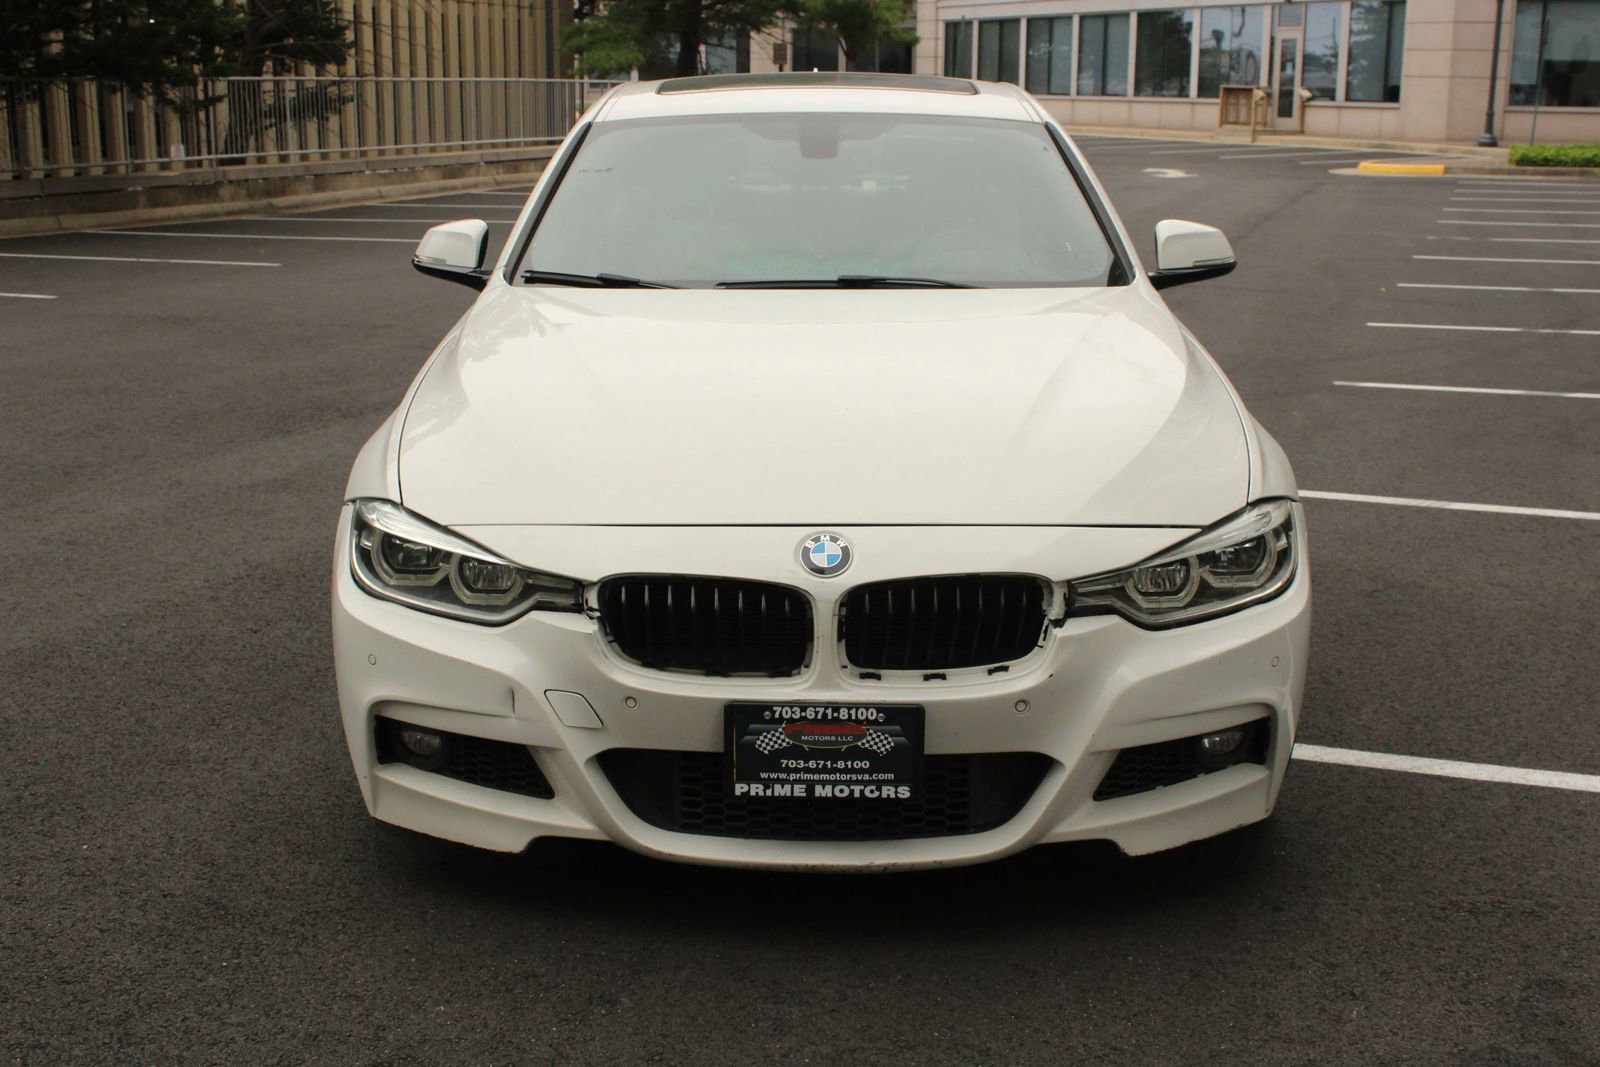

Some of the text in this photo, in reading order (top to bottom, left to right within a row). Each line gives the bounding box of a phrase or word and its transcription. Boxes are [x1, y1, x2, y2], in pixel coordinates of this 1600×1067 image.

[805, 535, 847, 548] BMW
[772, 706, 877, 720] 703-671-8100
[780, 759, 870, 769] 703-671-8100
[760, 771, 895, 781] www.primemotorsva.com
[815, 784, 911, 799] MOTORS
